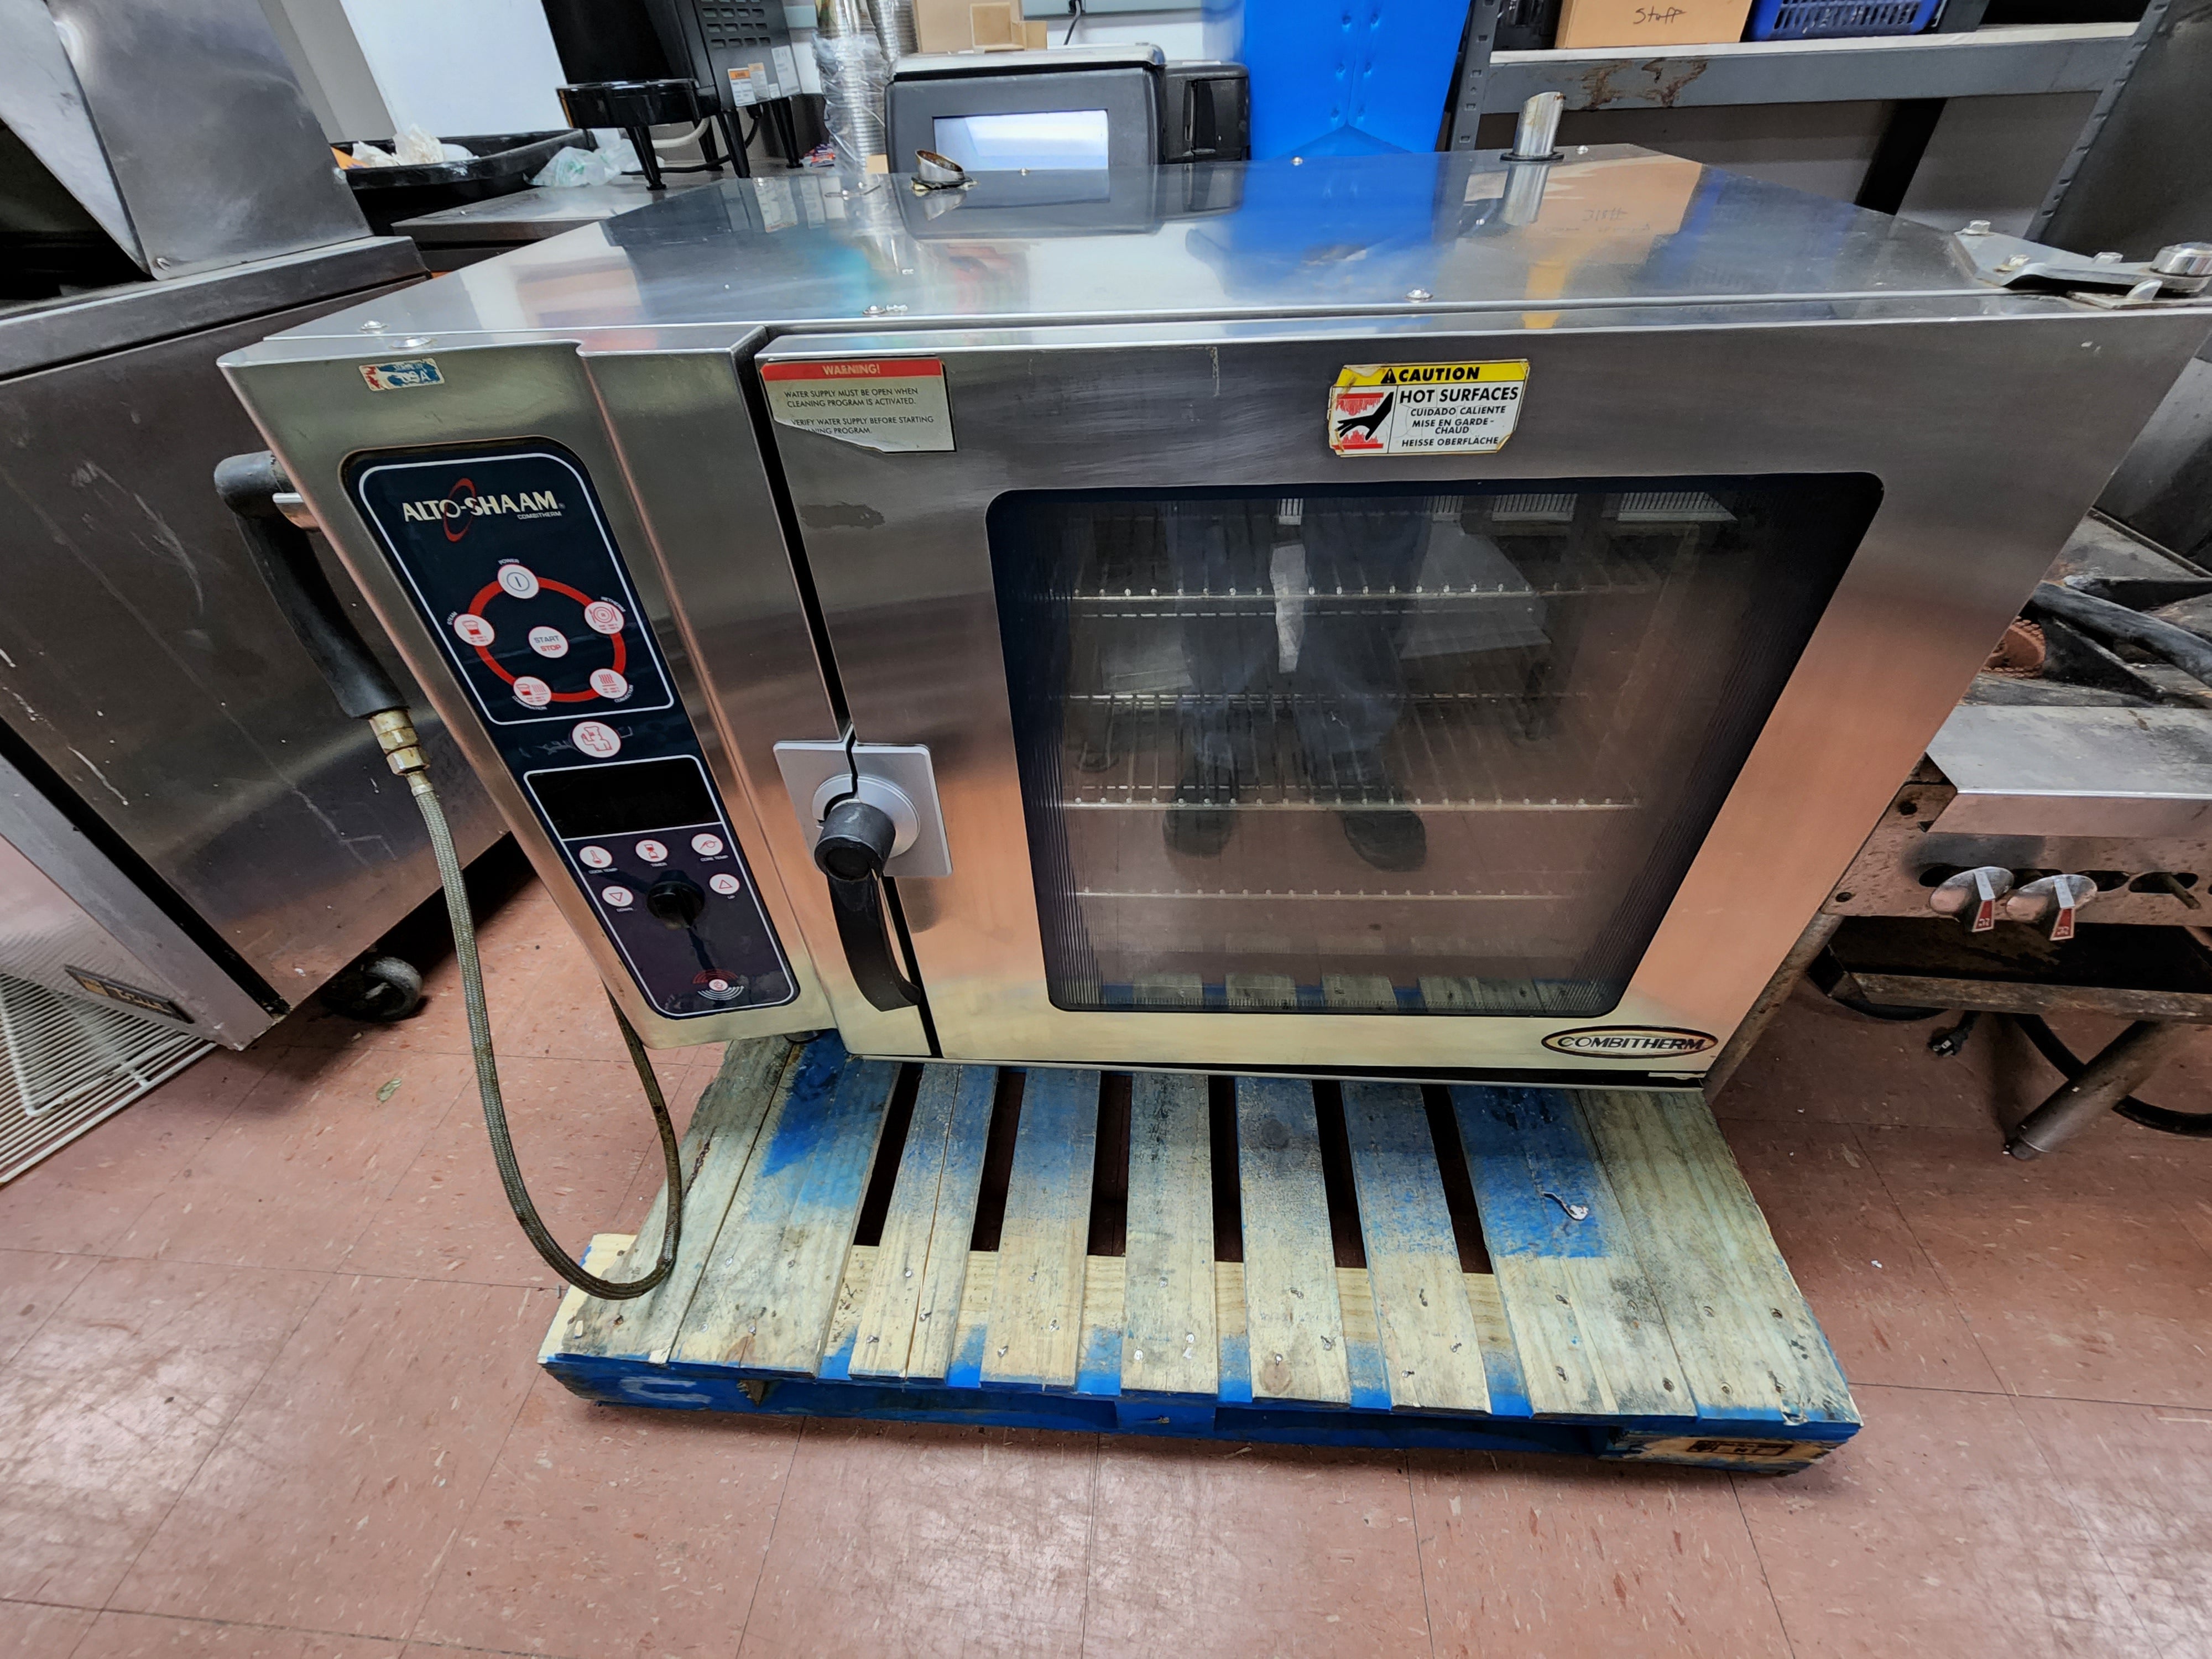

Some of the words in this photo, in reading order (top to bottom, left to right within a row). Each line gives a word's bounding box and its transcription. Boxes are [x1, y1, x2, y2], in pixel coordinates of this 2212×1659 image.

[822, 363, 881, 375] WARNING!
[1399, 367, 1480, 382] CAUTION
[838, 389, 858, 397] MUST
[1400, 389, 1435, 404] HOT
[1439, 387, 1519, 402] SURFACES
[1411, 408, 1456, 416] CUIDADO
[1460, 405, 1506, 415] CALIENTE
[1412, 419, 1436, 427] MISE
[1401, 439, 1434, 447] HEISSE
[1437, 435, 1499, 446] OBERFLÄCHE
[517, 510, 562, 520] COMBITHERM
[540, 644, 562, 652] STOP
[1557, 1036, 1707, 1050] COMBITHERM
